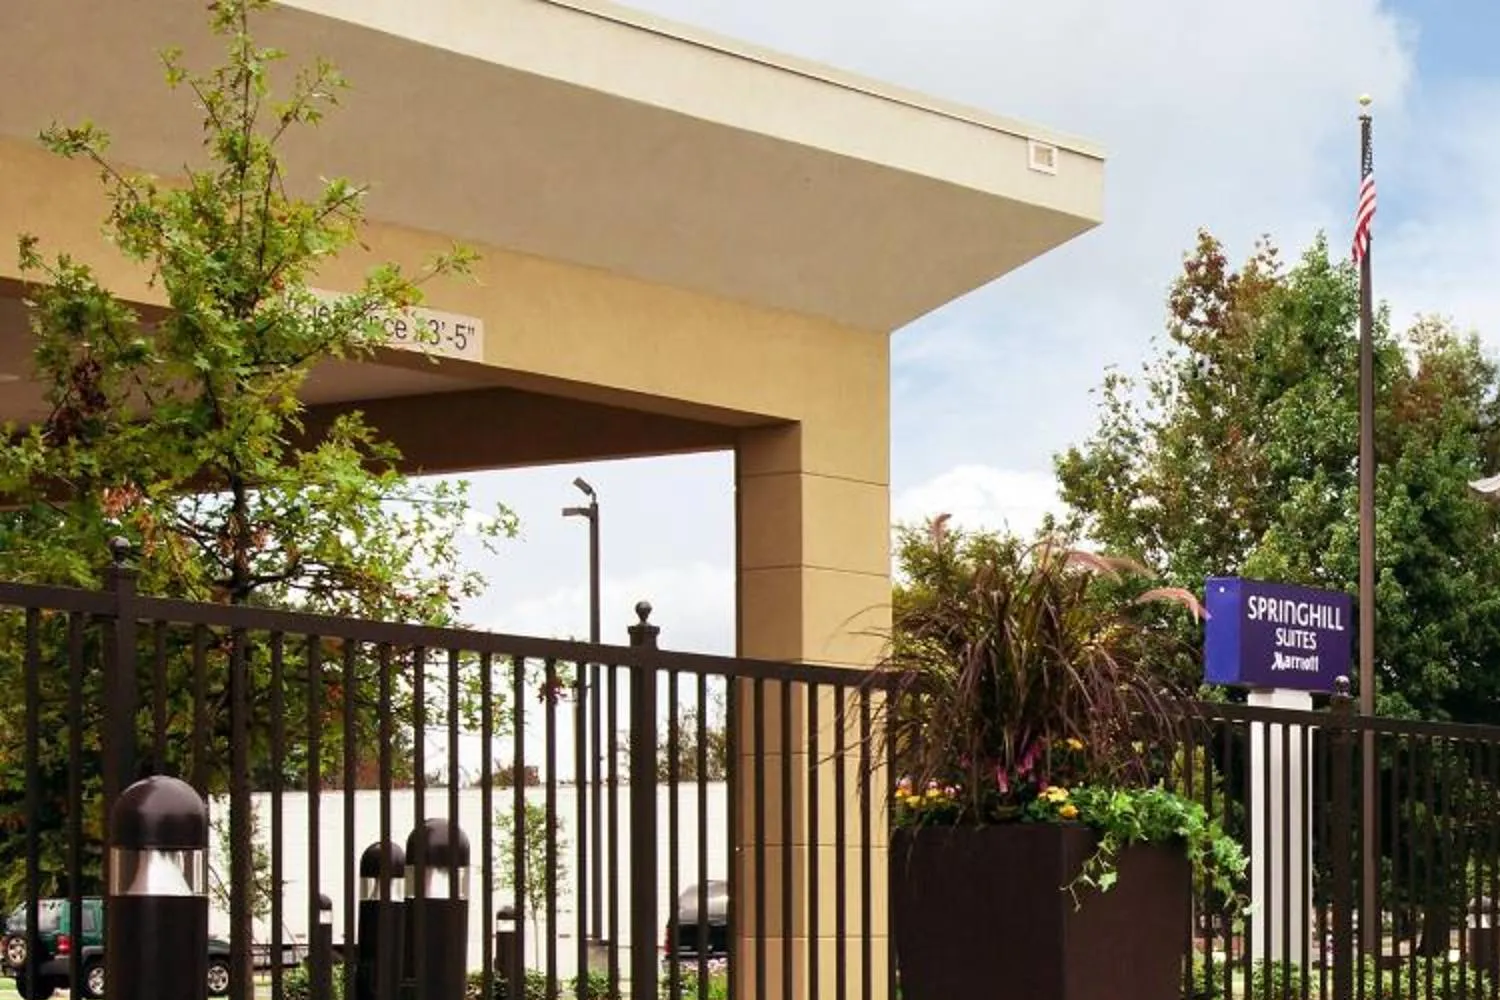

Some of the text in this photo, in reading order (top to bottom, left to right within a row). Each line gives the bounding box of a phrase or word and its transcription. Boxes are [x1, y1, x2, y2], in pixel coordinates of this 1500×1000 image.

[1248, 595, 1344, 631] SPRINGHILL
[1275, 628, 1317, 650] SUITES
[1271, 651, 1319, 672] Marriott
